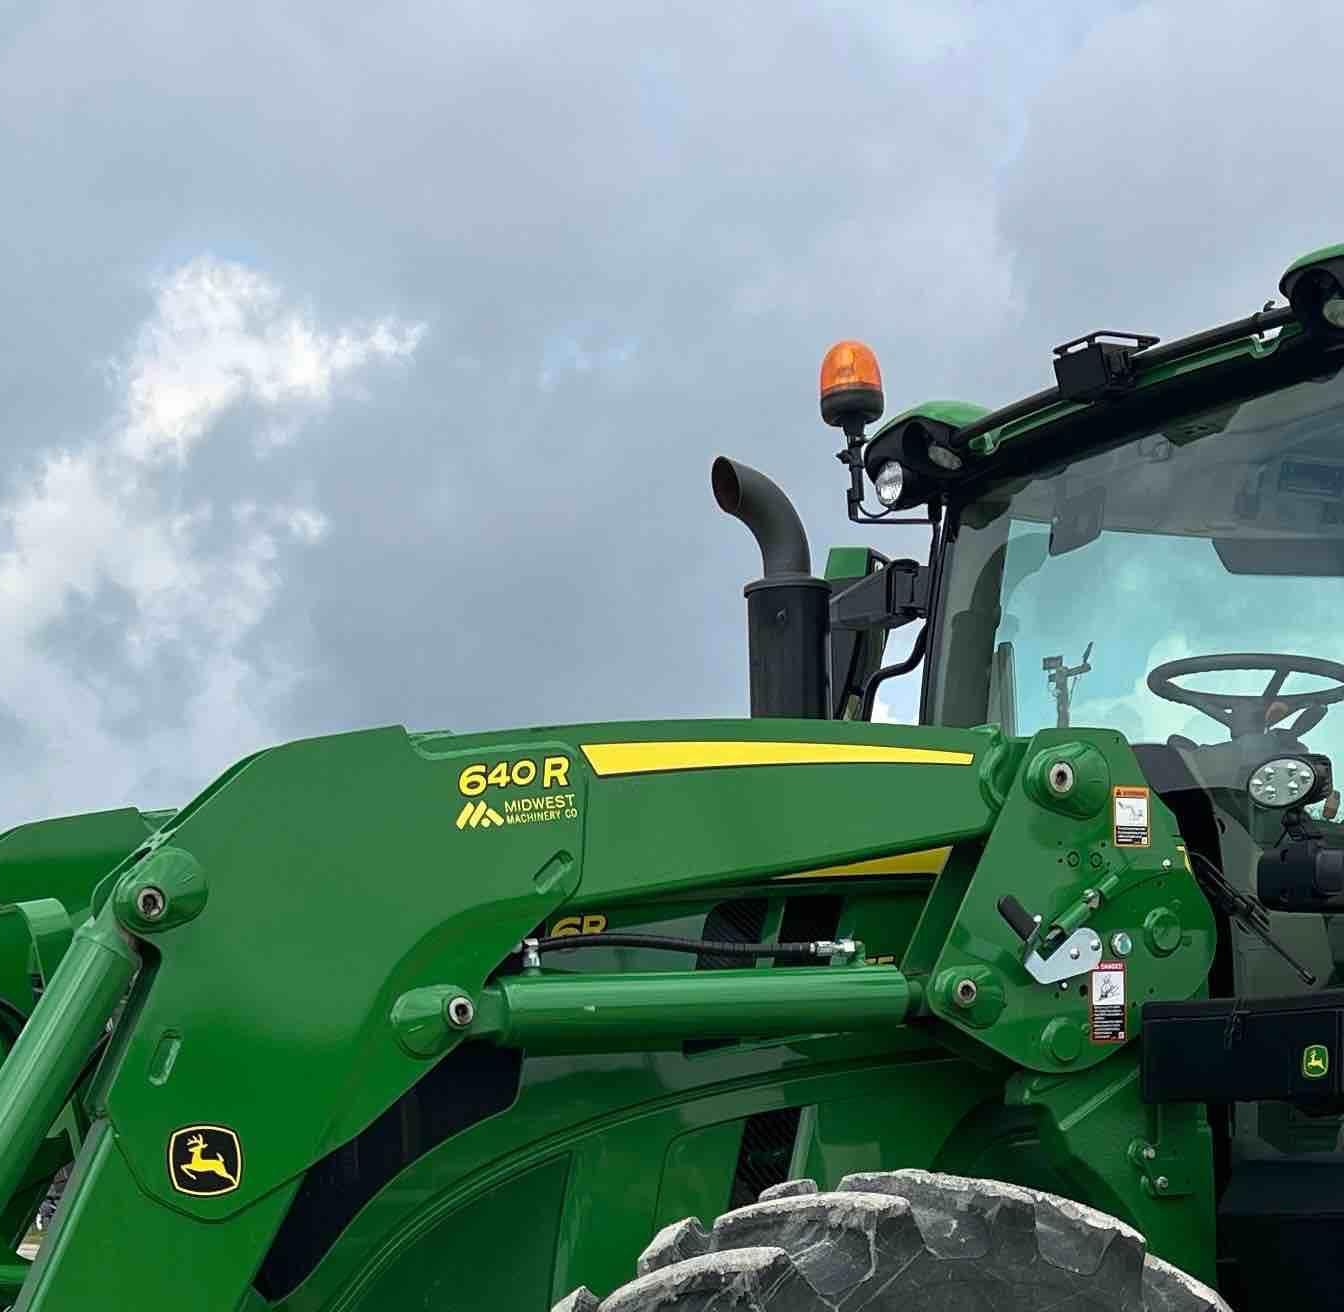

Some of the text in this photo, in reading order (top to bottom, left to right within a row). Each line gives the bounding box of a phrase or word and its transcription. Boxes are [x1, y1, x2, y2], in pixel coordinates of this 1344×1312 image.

[504, 793, 575, 813] MIDWEST
[506, 808, 578, 825] MACHINERY CO
